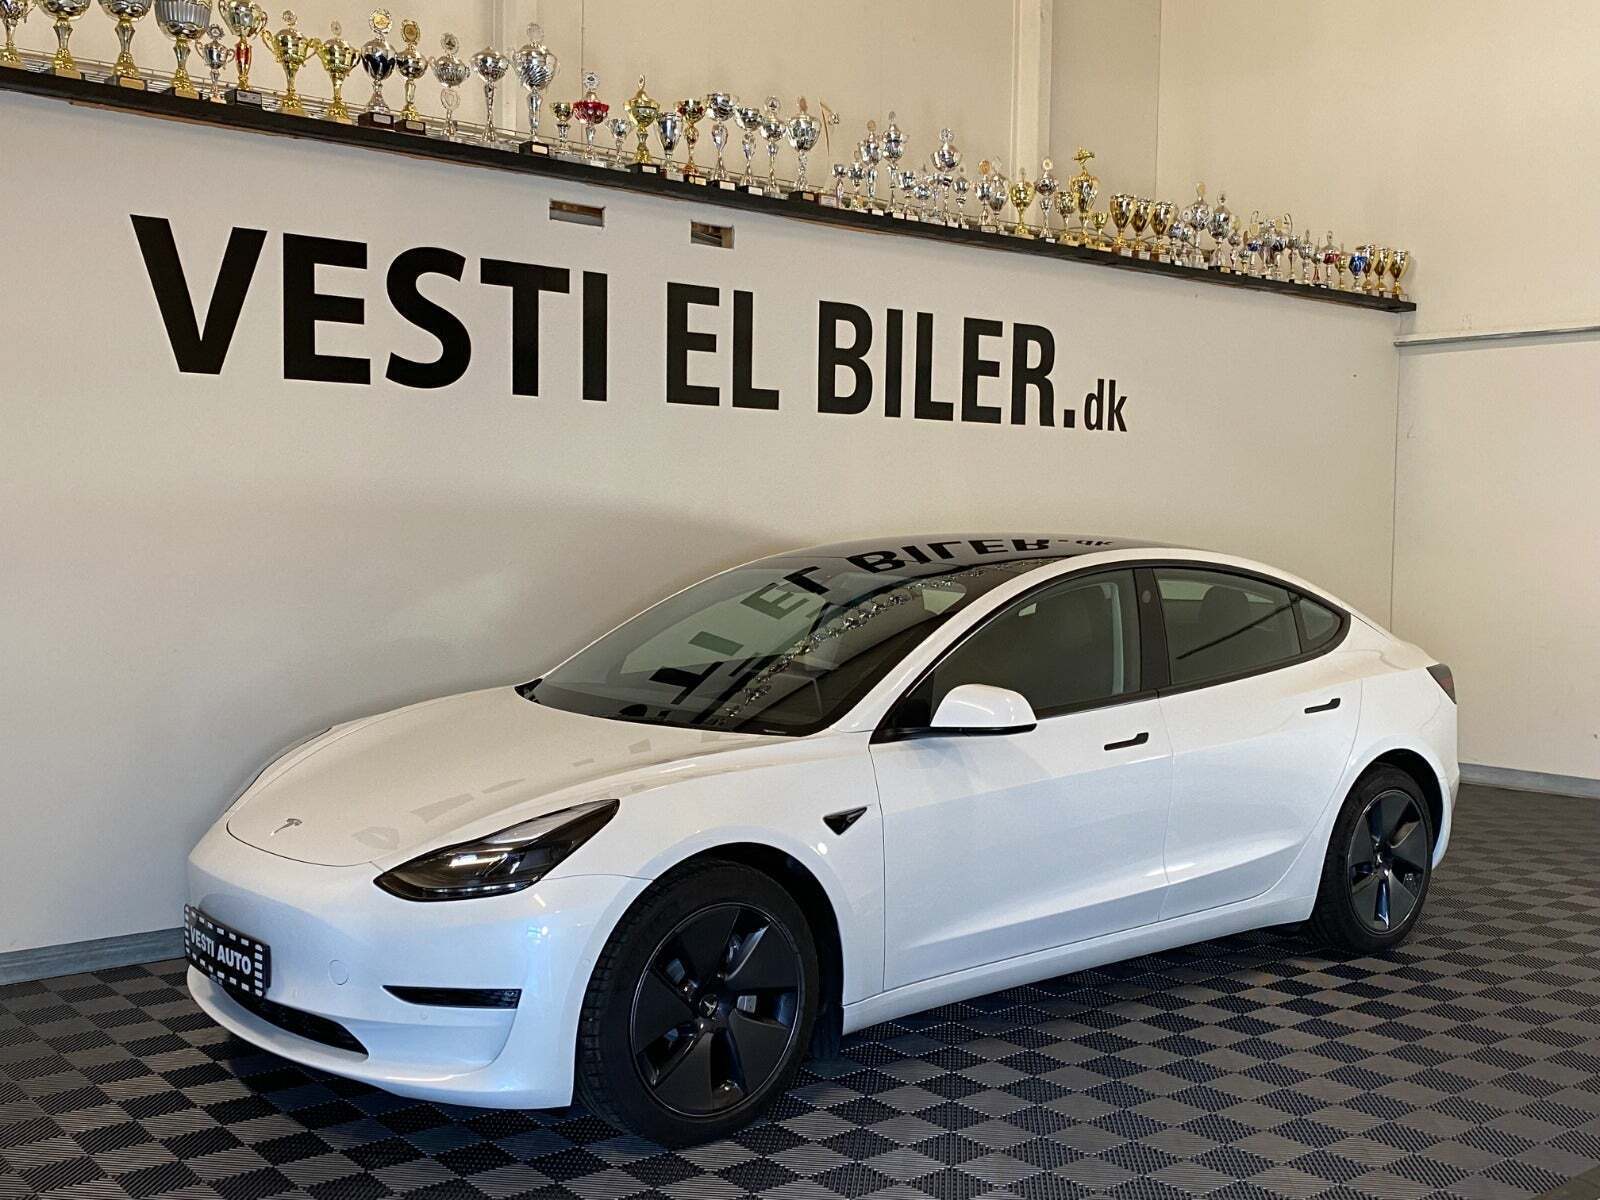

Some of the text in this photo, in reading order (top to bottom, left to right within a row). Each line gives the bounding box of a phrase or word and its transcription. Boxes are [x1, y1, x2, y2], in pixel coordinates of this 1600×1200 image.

[130, 215, 608, 402] VESTI
[667, 282, 780, 411] EL
[190, 925, 251, 975] VESTI AUTO
